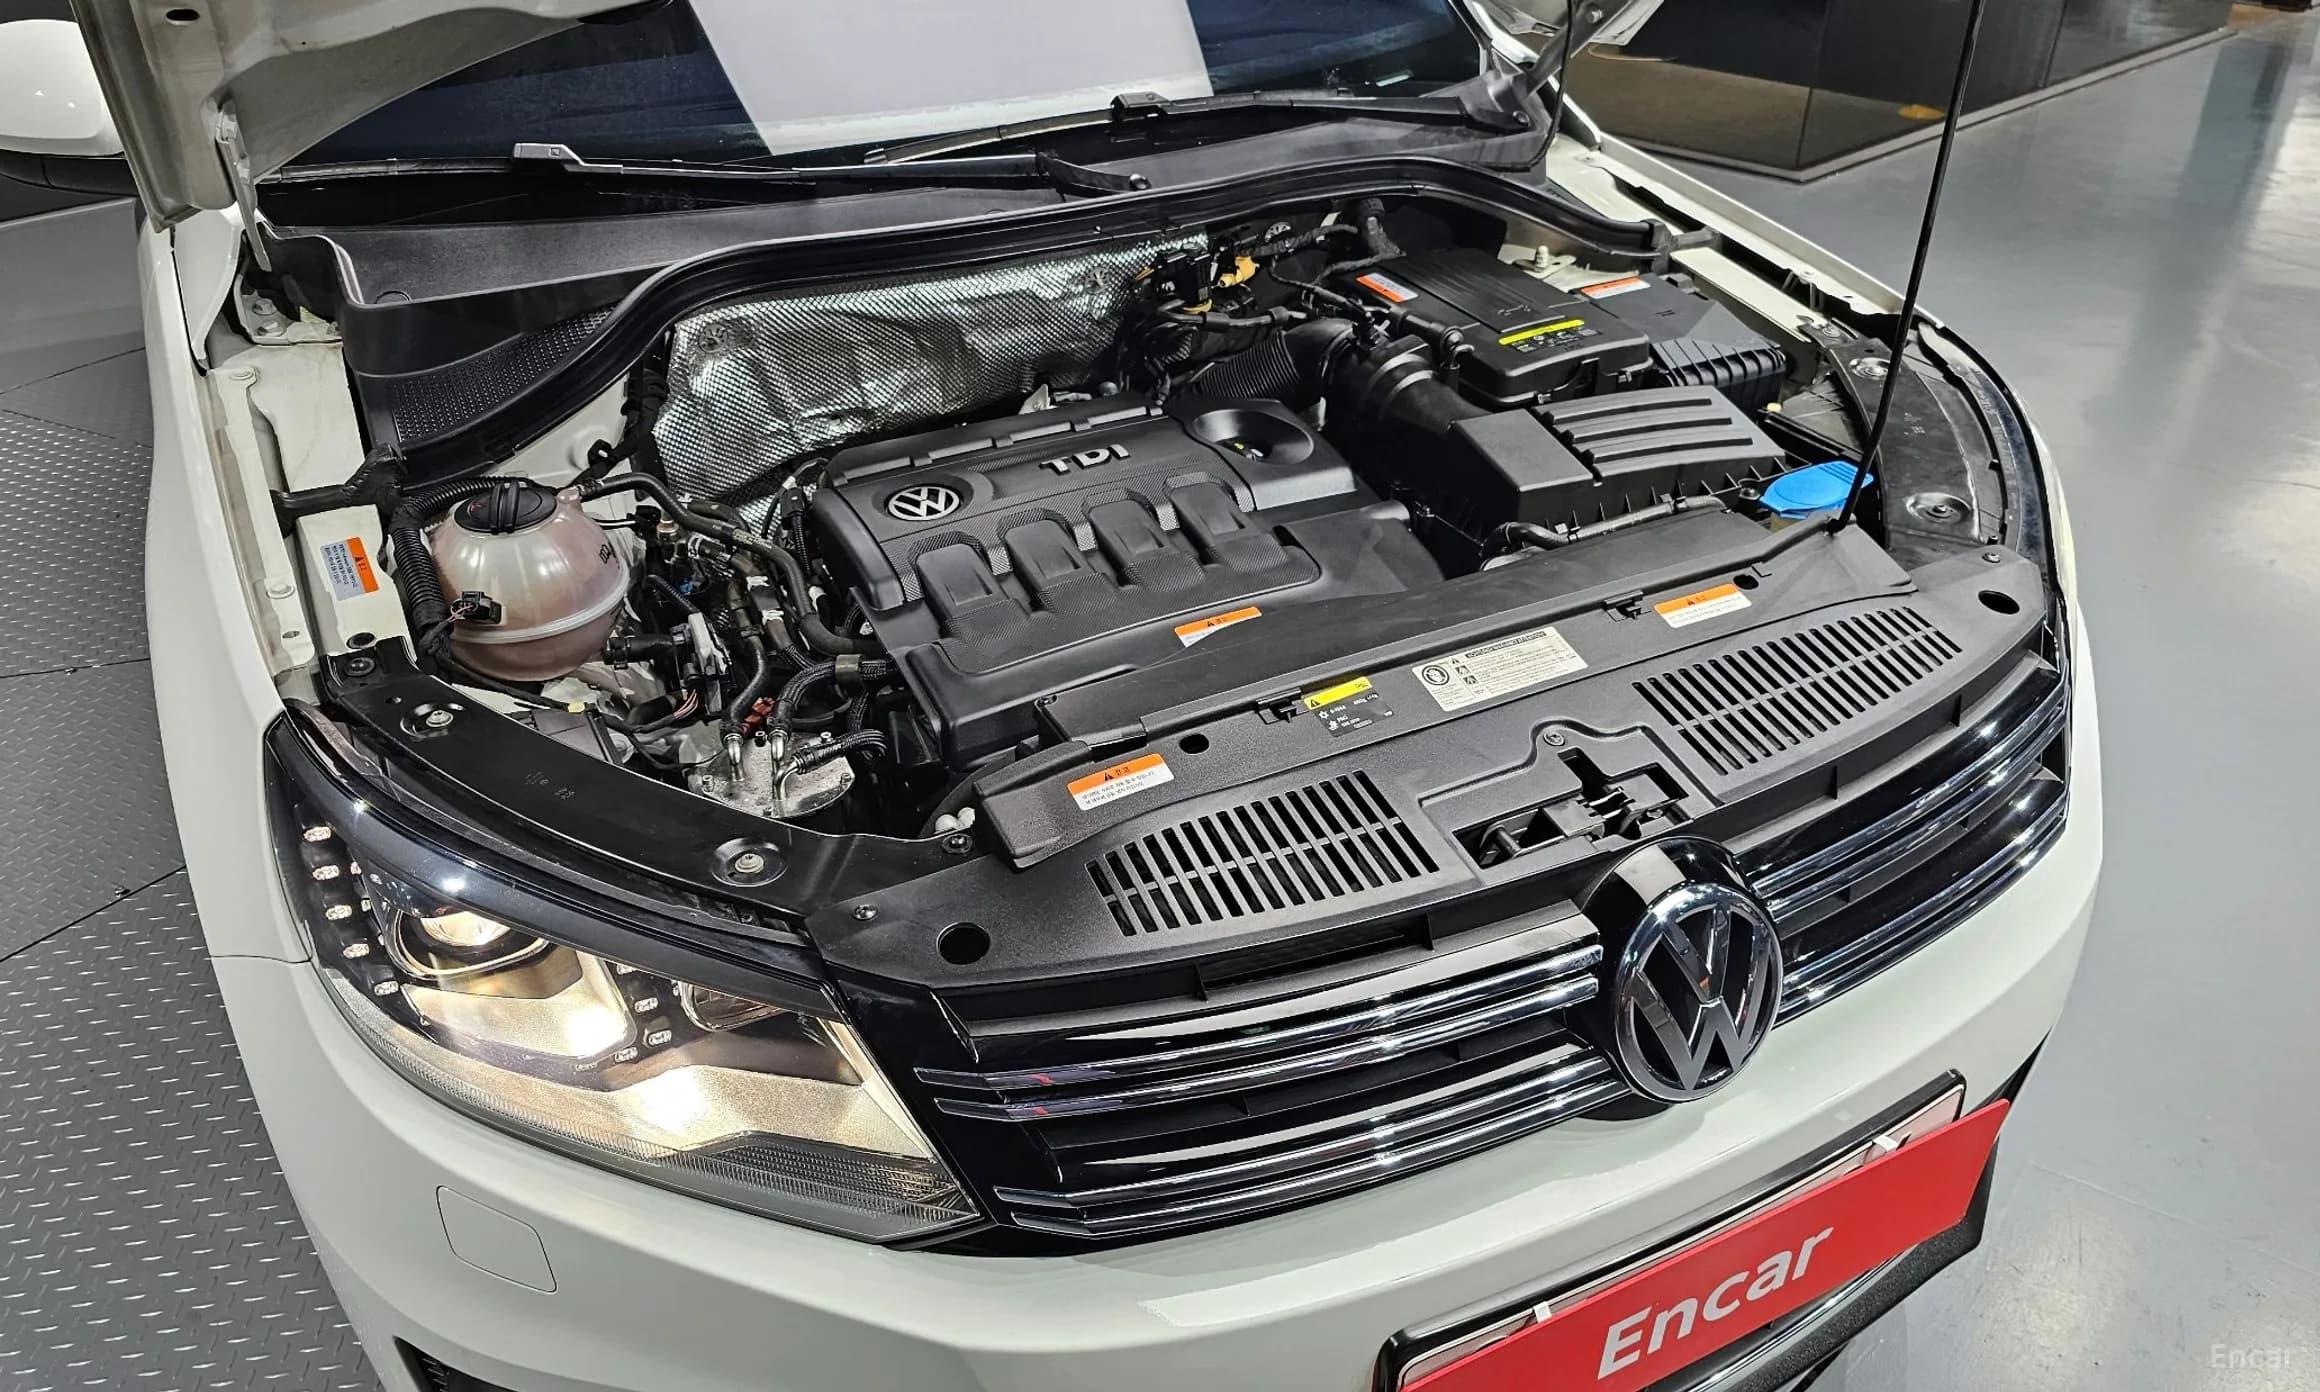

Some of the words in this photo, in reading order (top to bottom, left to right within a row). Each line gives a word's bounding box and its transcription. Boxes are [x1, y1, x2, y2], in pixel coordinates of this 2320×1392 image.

[887, 485, 961, 521] VW
[1039, 443, 1130, 475] TDI
[1617, 883, 1782, 1101] VW
[1598, 1226, 1833, 1379] Encar
